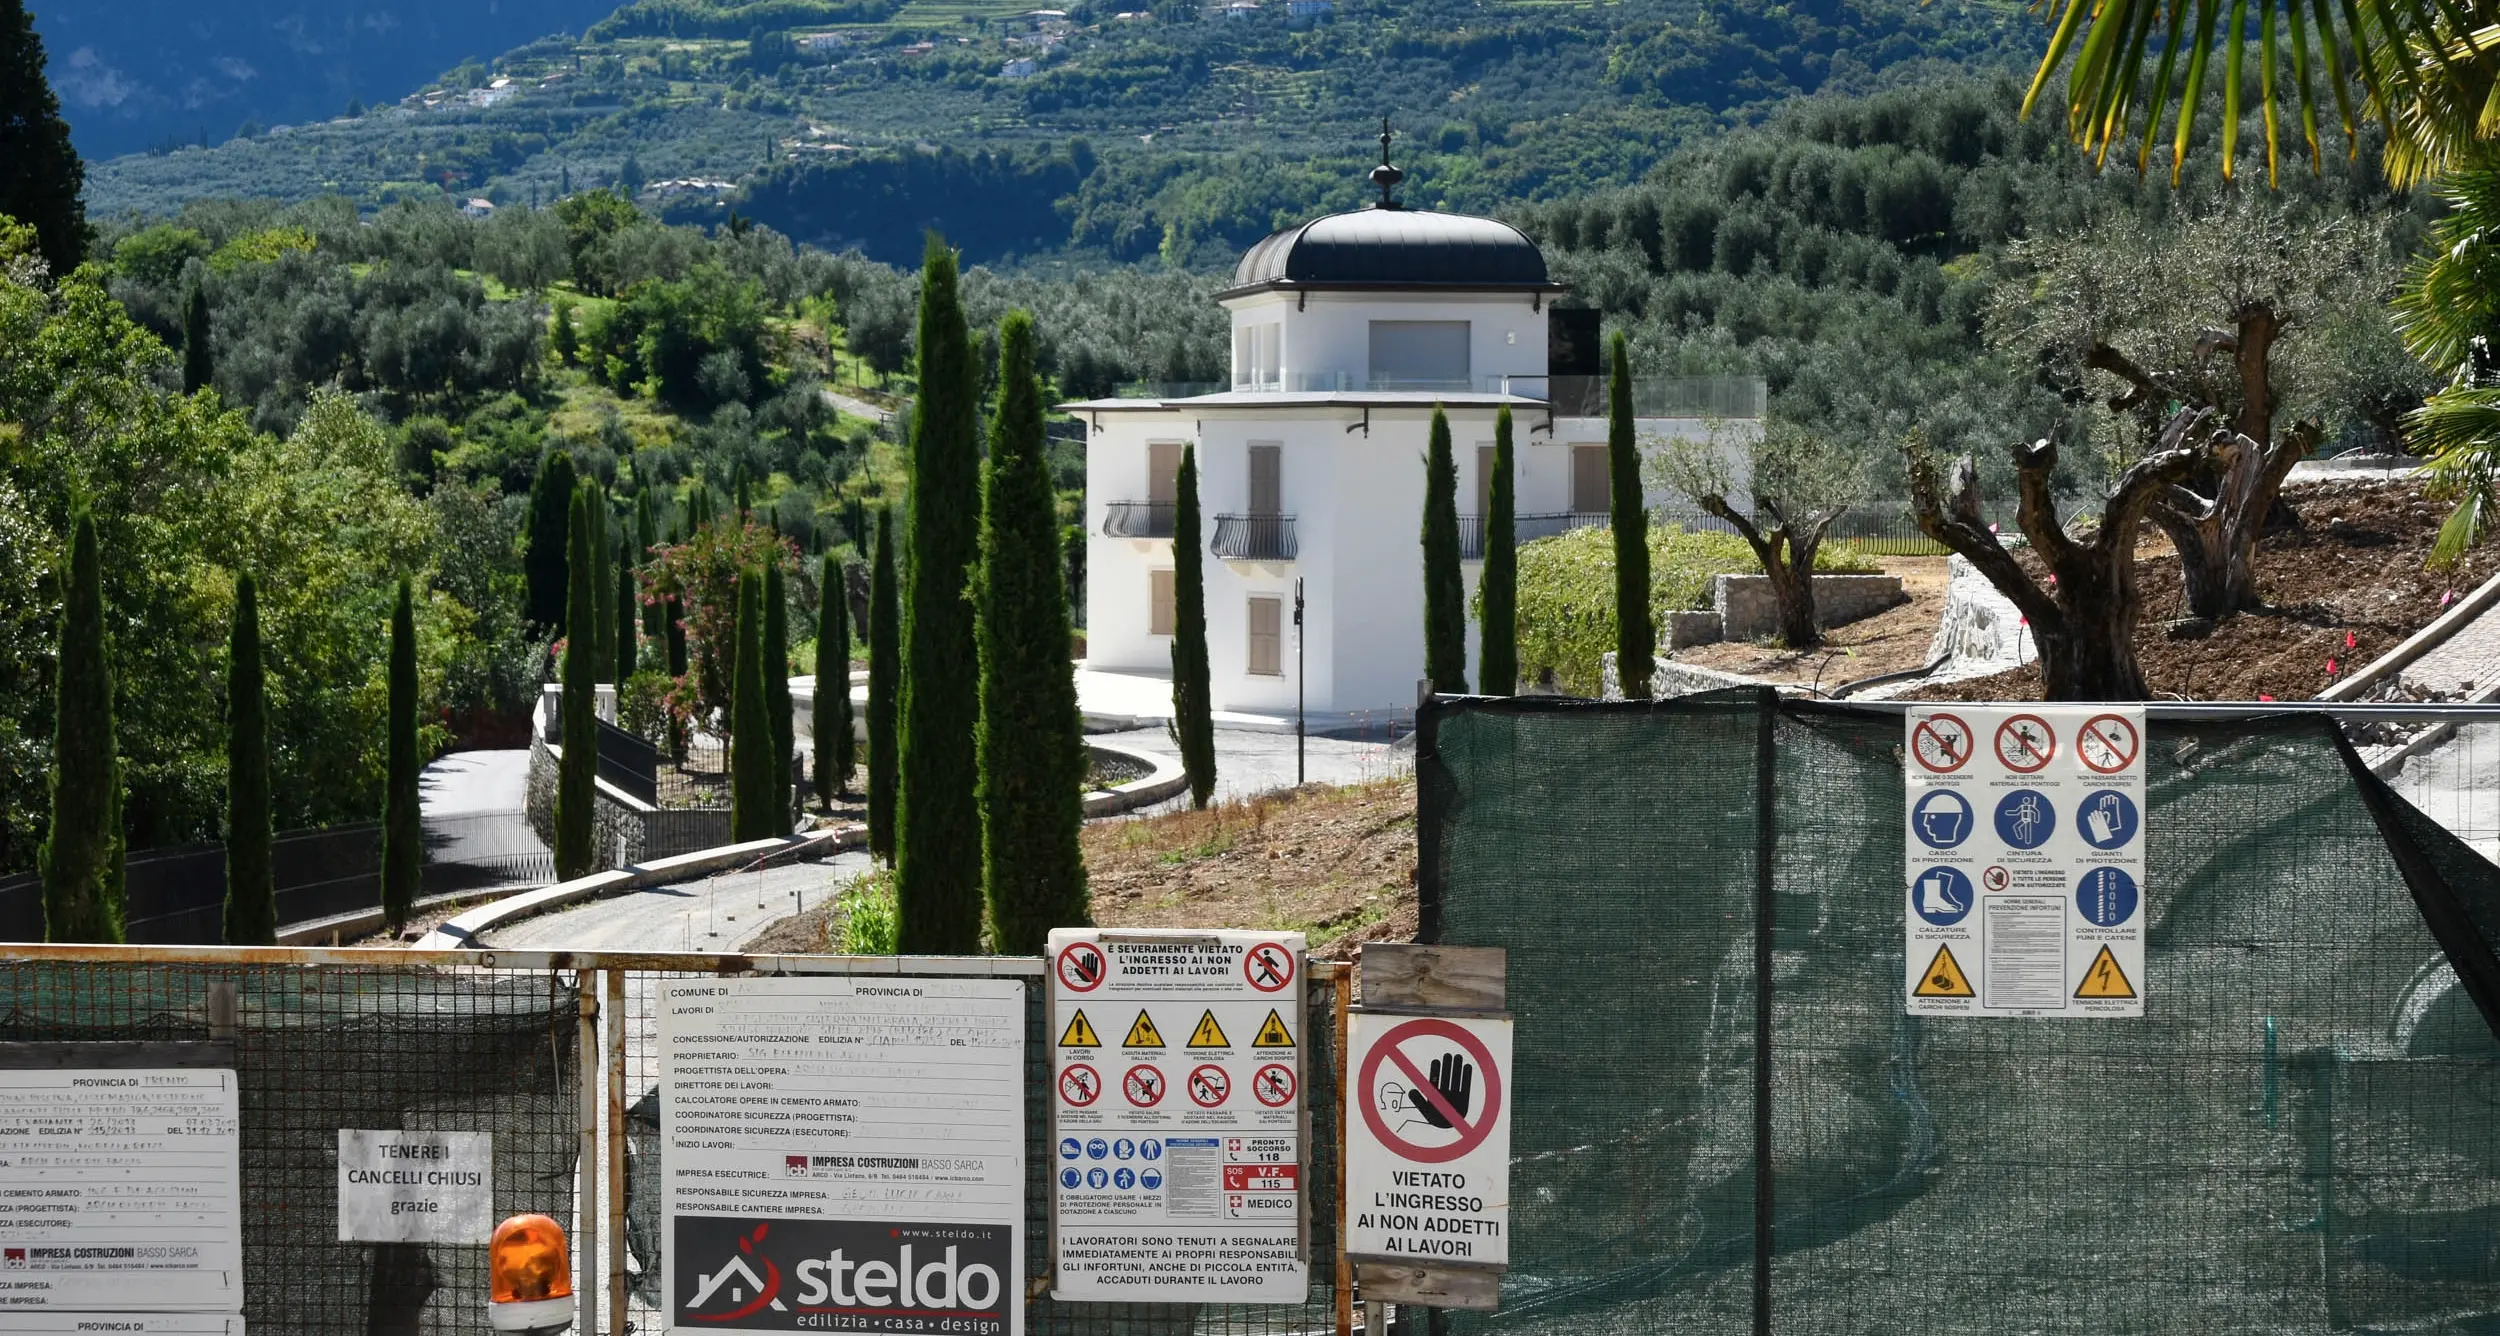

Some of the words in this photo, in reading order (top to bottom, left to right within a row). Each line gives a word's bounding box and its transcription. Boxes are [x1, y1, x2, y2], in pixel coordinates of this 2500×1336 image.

[1118, 945, 1197, 953] SEVERAMENTE
[1198, 945, 1242, 953] VIETATO
[1120, 956, 1186, 964] L'INGRESSO
[1192, 956, 1202, 964] AI
[1208, 956, 1231, 964] NON
[1188, 967, 1228, 975] LAVORI
[671, 988, 715, 997] COMUNE
[856, 988, 910, 996] PROVINCIA
[832, 1098, 862, 1106] ARMATO:
[676, 1126, 742, 1134] COORDINATORE
[745, 1127, 790, 1135] SICUREZZA
[379, 1144, 440, 1159] TENERE
[445, 1146, 449, 1159] I
[1258, 1153, 1280, 1162] 118
[813, 1157, 854, 1167] IMPRESA
[858, 1156, 918, 1168] COSTRUZIONI
[922, 1159, 951, 1170] BASSO
[954, 1160, 984, 1170] SARCA
[1227, 1167, 1243, 1175] SOS
[1257, 1167, 1283, 1177] V.F.
[348, 1170, 422, 1184] CANCELLI
[428, 1172, 480, 1185] CHIUSI
[1393, 1172, 1465, 1189] VIETATO
[1261, 1180, 1281, 1189] 115
[676, 1188, 739, 1196] RESPONSABILE
[742, 1190, 788, 1198] SICUREZZA
[391, 1199, 437, 1215] grazie
[1248, 1199, 1292, 1208] MEDICO
[1376, 1193, 1482, 1212] L'INGRESSO
[676, 1203, 739, 1211] RESPONSABILE
[742, 1205, 782, 1213] CANTIERE
[785, 1206, 824, 1214] IMPRESA:
[1358, 1214, 1374, 1228] AI
[1381, 1215, 1417, 1230] NON
[1424, 1218, 1499, 1235] ADDETTI
[903, 1230, 991, 1238] www.steldo.it
[1063, 1237, 1065, 1245] I
[1070, 1237, 1137, 1245] LAVORATORI
[1142, 1237, 1172, 1245] SONO
[1232, 1238, 1297, 1246] SEGNALARE
[1386, 1237, 1401, 1252] AI
[1408, 1239, 1471, 1257] LAVORI
[30, 1248, 71, 1258] IMPRESA
[74, 1248, 134, 1258] COSTRUZIONI
[1063, 1250, 1158, 1258] IMMEDIATAMENTE
[1220, 1250, 1298, 1259] RESPONSABILI
[1063, 1263, 1079, 1271] GLI
[1084, 1263, 1144, 1273] INFORTUNI,
[1149, 1263, 1186, 1271] ANCHE
[1190, 1263, 1200, 1271] DI
[1257, 1261, 1298, 1272] ENTITÀ,
[797, 1244, 1000, 1309] steldo
[1097, 1276, 1150, 1284] ACCADUTI
[1155, 1276, 1204, 1284] DURANTE
[78, 1323, 131, 1331] PROVINCIA
[134, 1323, 143, 1331] DI
[797, 1314, 867, 1327] edilizia
[885, 1319, 923, 1329] casa
[941, 1318, 999, 1334] design
